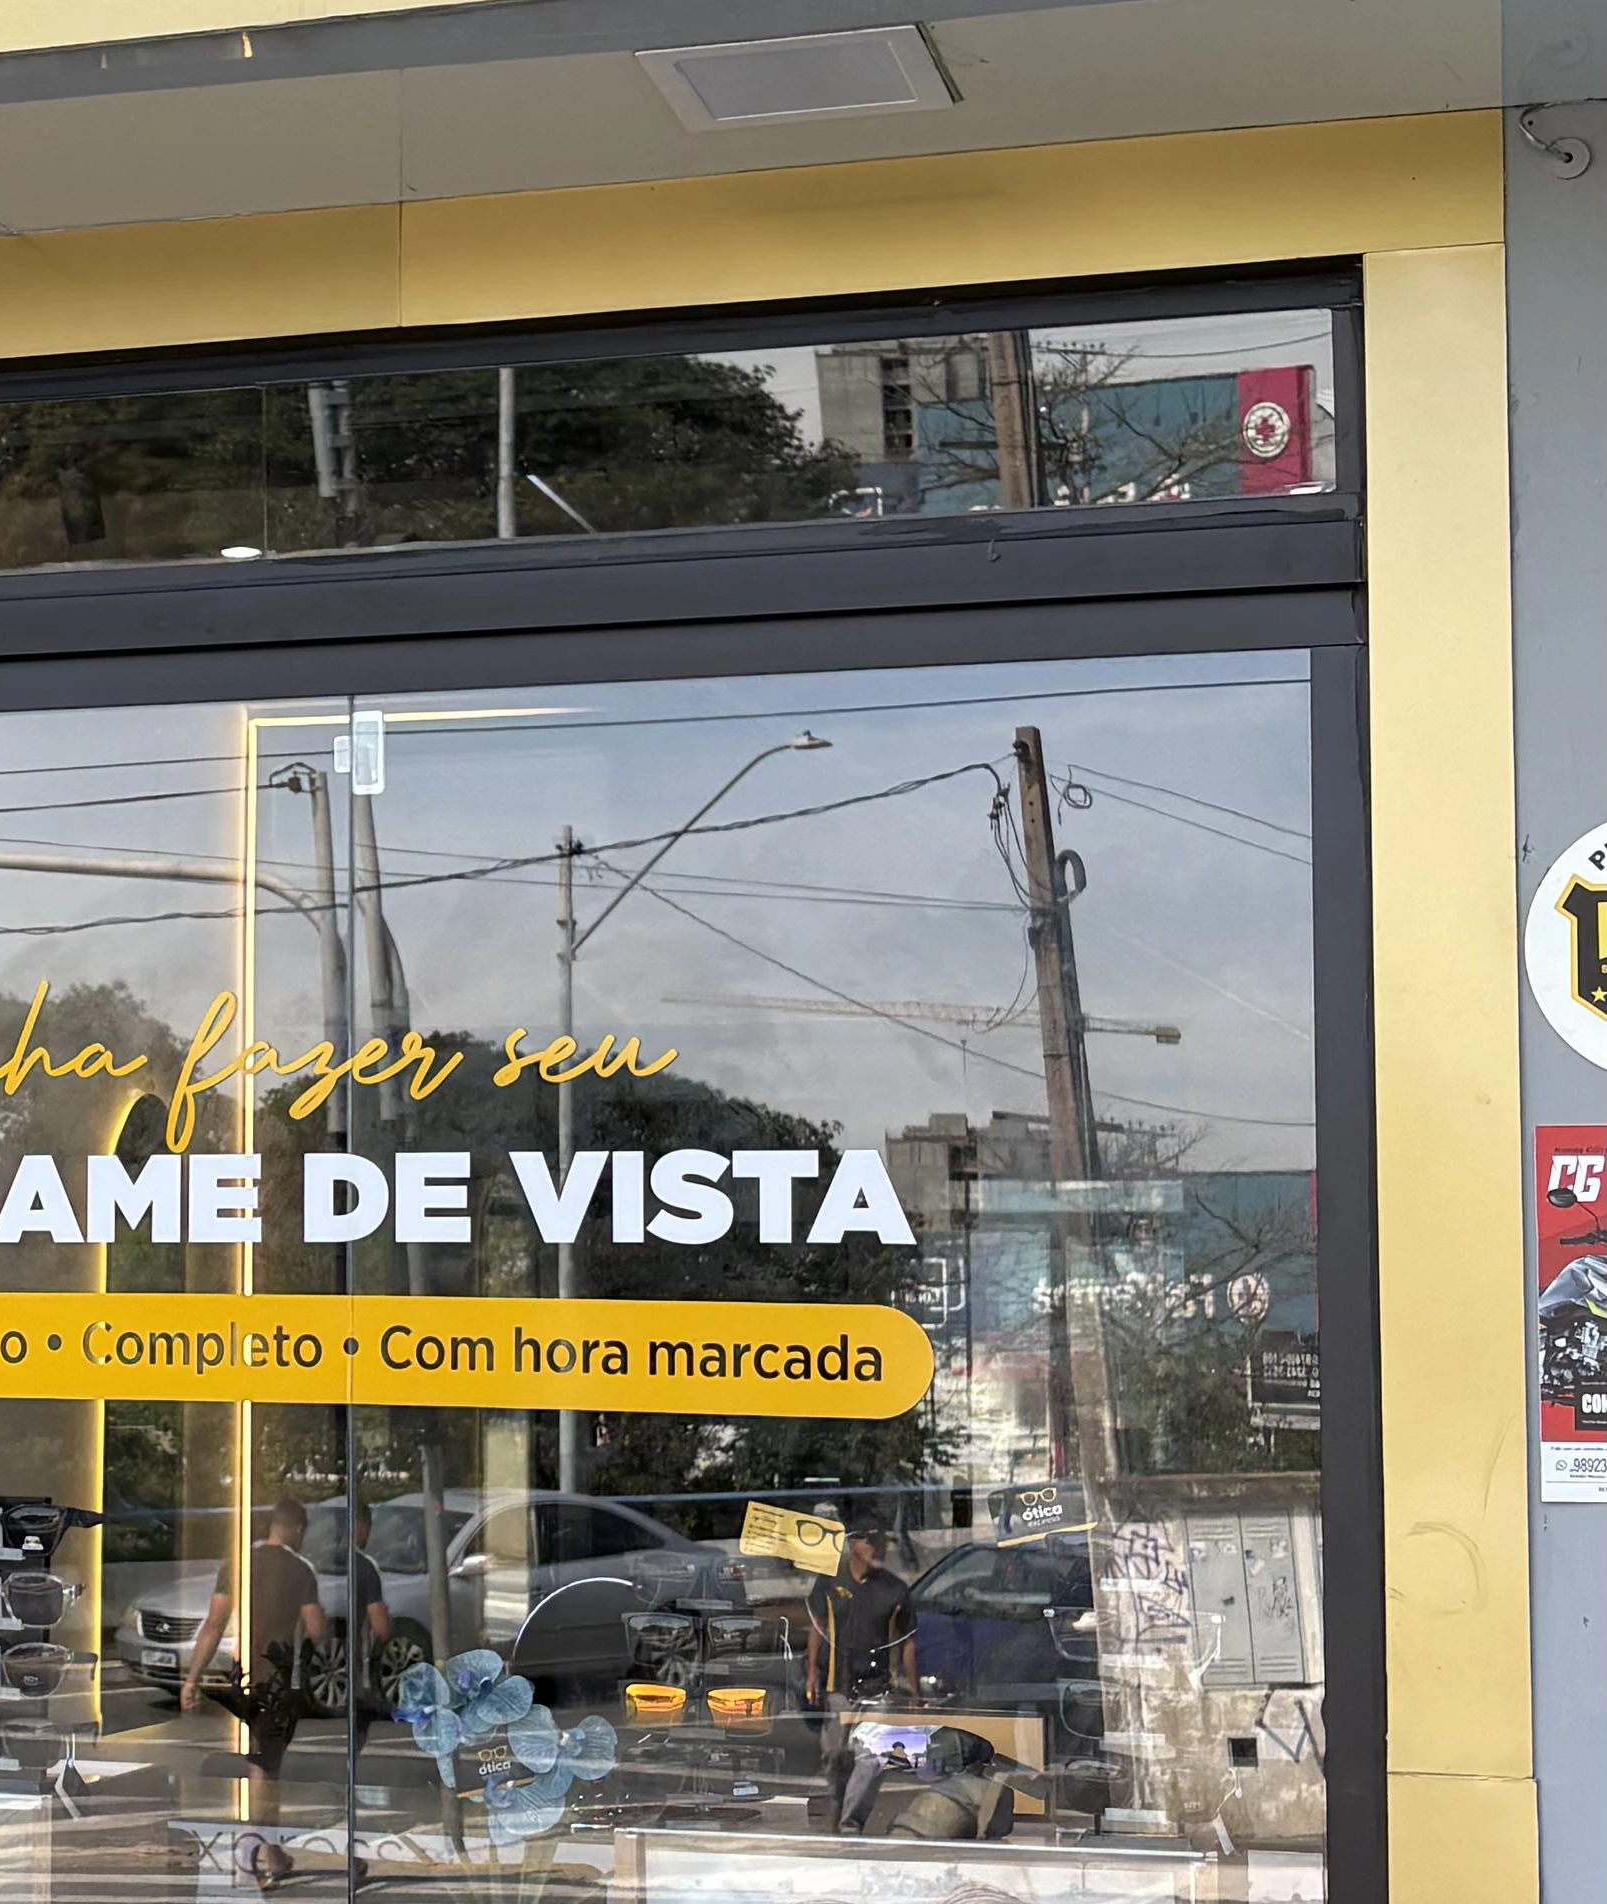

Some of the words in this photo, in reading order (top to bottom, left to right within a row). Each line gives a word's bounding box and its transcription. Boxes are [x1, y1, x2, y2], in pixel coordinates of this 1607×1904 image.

[166, 991, 465, 1153] fazer
[492, 1026, 680, 1088] seu
[303, 1151, 472, 1245] DE
[508, 1148, 916, 1247] VISTA
[82, 1320, 323, 1375] Completo
[380, 1325, 497, 1373] Com
[514, 1327, 630, 1378] hora
[647, 1330, 885, 1384] marcada
[1022, 1505, 1063, 1521] ótica
